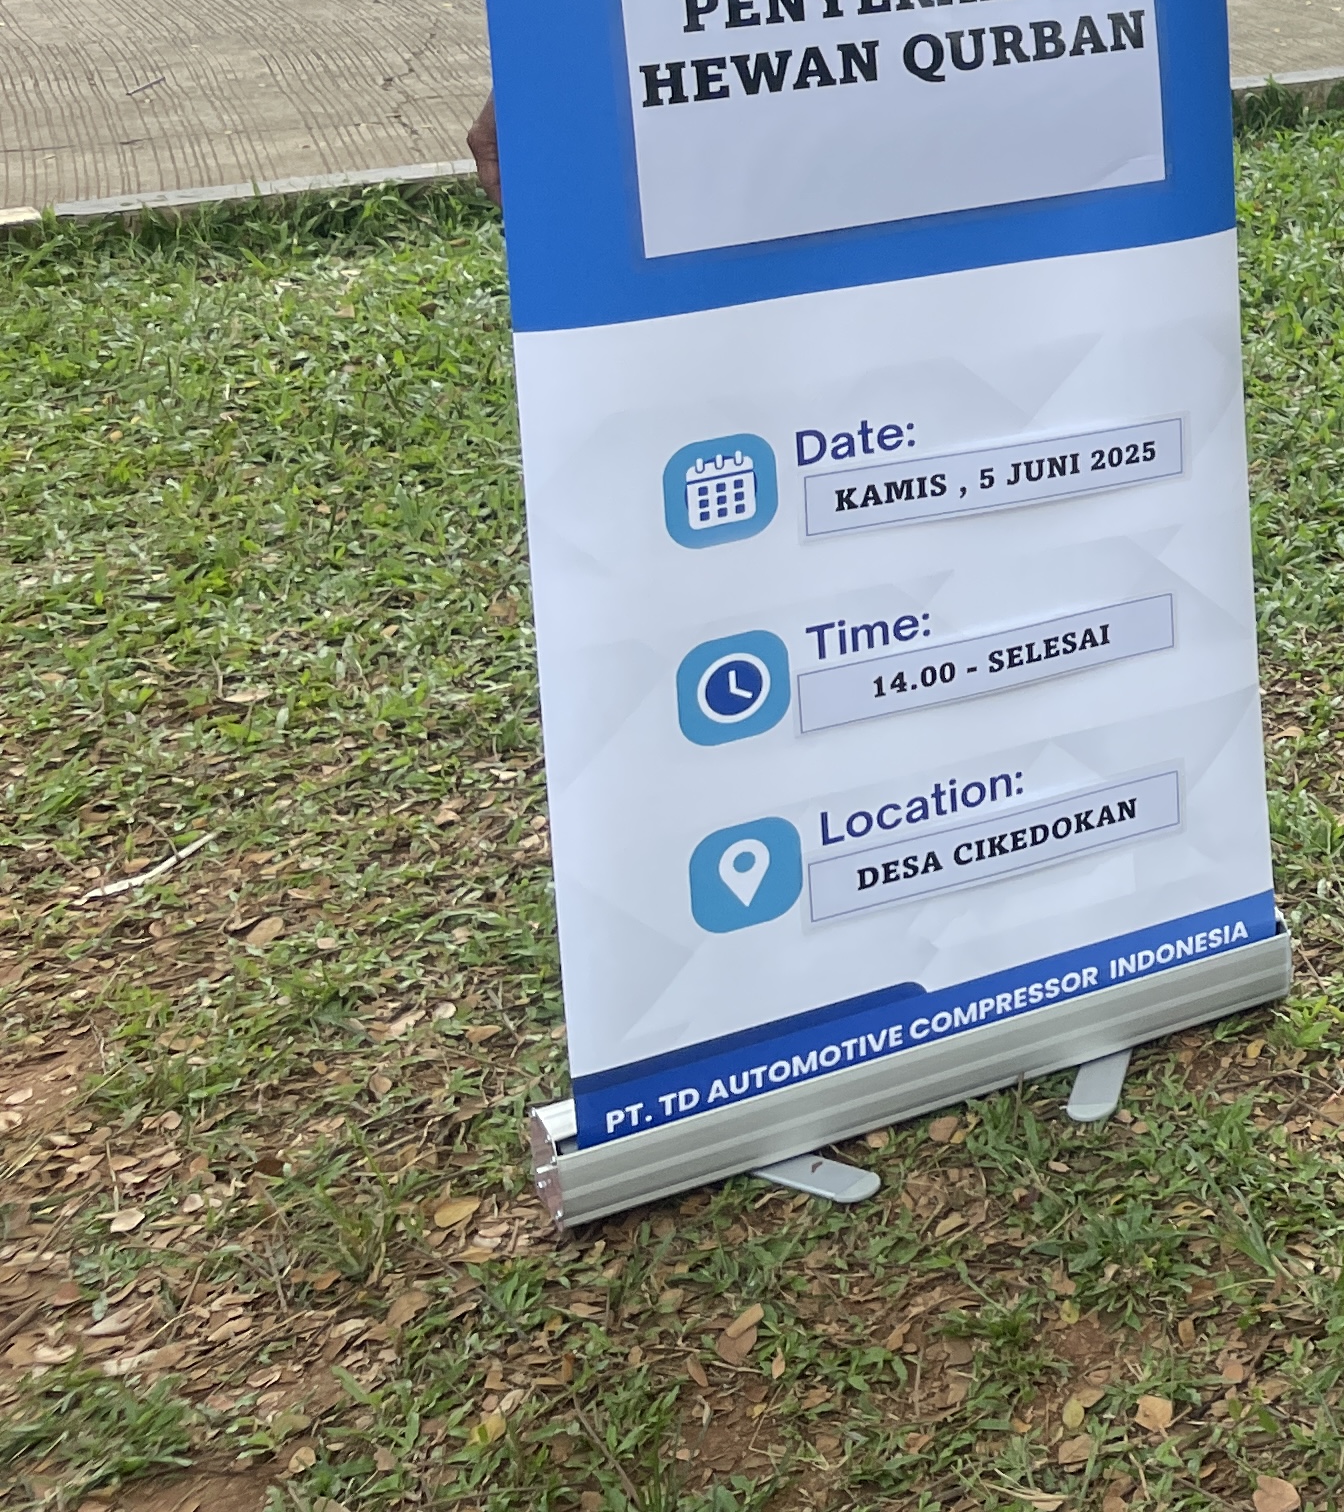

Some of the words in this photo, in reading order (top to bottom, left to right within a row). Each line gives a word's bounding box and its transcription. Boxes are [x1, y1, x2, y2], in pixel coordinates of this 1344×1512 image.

[640, 40, 880, 107] HEWAN
[903, 10, 1145, 82] QURBAN
[796, 420, 916, 467] Date:
[835, 473, 947, 512] KAMIS
[979, 468, 995, 490] 5
[1007, 453, 1081, 486] JUNI
[1090, 441, 1157, 472] 2025
[806, 612, 931, 660] Time:
[873, 662, 956, 698] 14.00
[988, 624, 1111, 674] SELESAI
[820, 771, 1024, 846] Location:
[857, 850, 943, 891] DESA
[953, 798, 1138, 866] CIKEDOKAN
[606, 1102, 653, 1134] PT.
[659, 1087, 700, 1117] TD
[707, 1024, 903, 1104] AUTOMOTIVE
[909, 966, 1099, 1040] COMPRESSOR
[1109, 920, 1249, 980] INDONESIA
